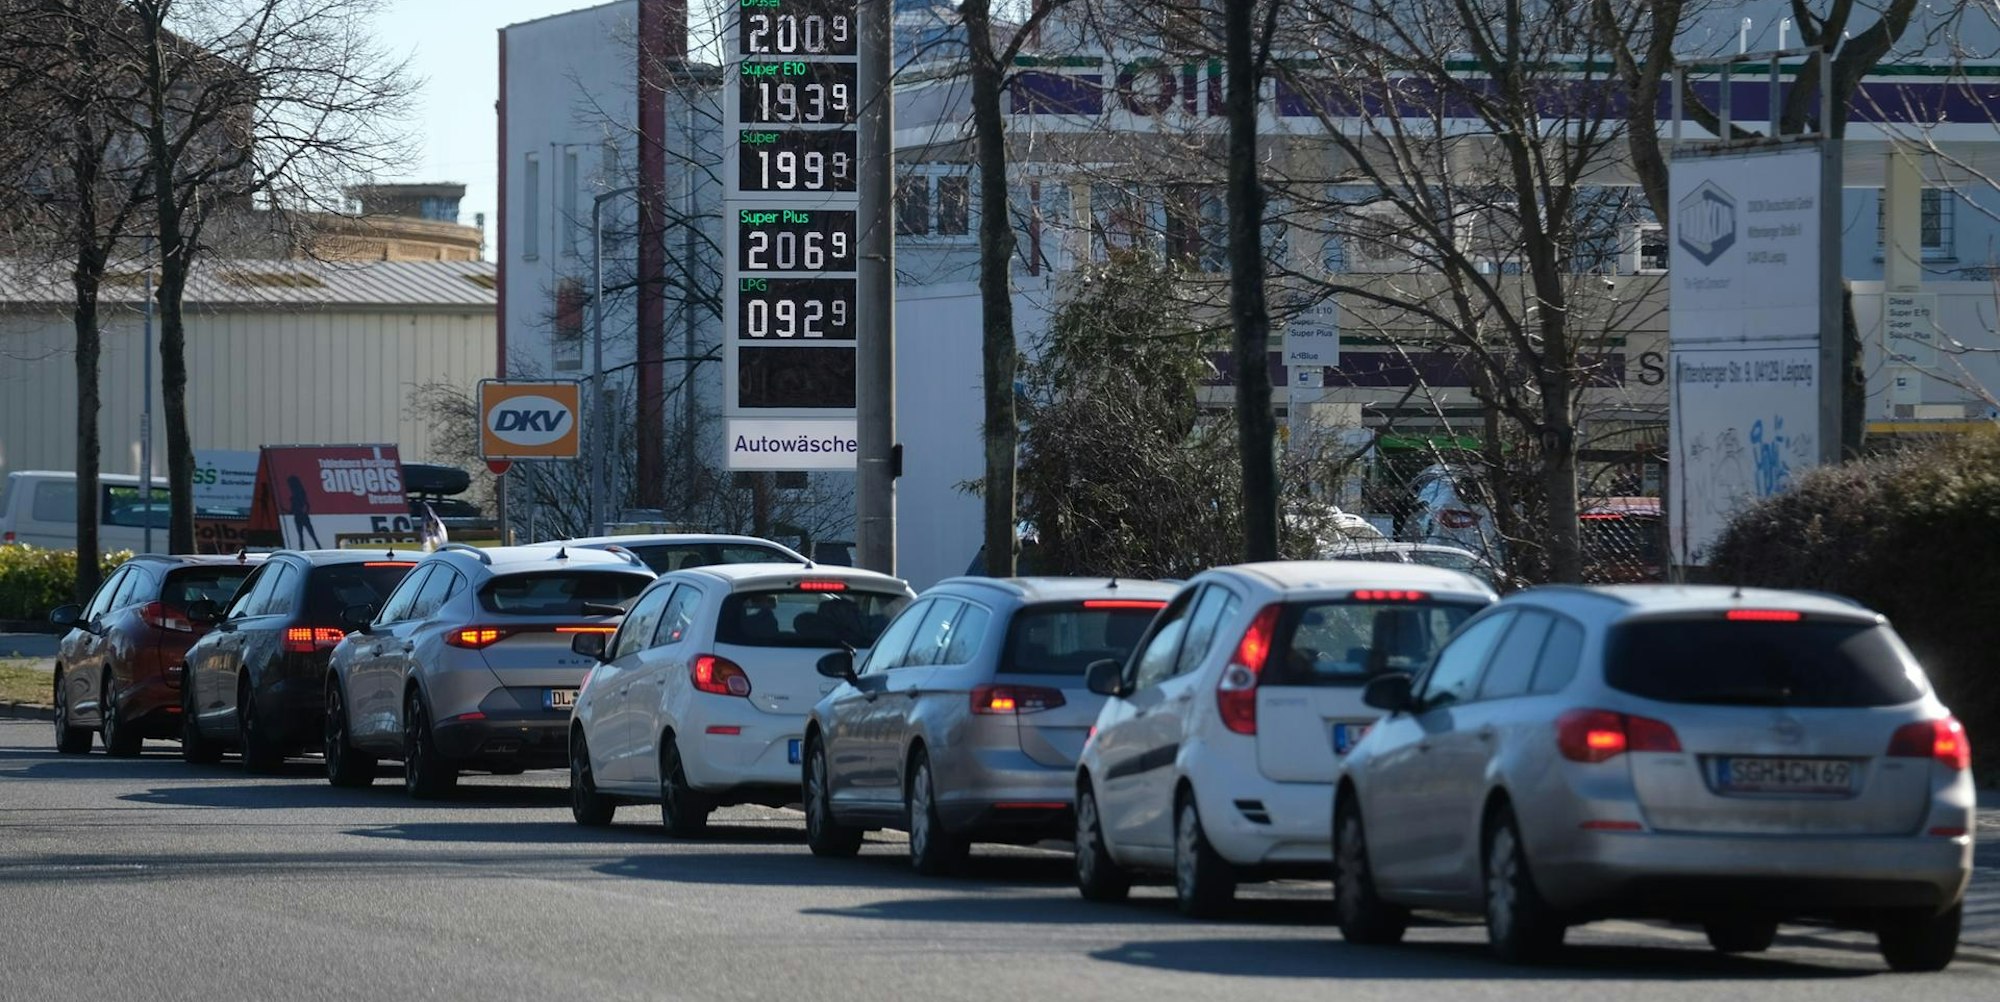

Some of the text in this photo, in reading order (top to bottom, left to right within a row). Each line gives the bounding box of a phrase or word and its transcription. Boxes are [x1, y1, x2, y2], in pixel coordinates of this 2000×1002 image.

[741, 62, 807, 77] Super E10
[741, 131, 779, 146] Super
[741, 210, 809, 224] Super Plus
[741, 278, 768, 292] LPG
[1889, 308, 1912, 316] Super
[1290, 328, 1333, 338] Super Plus
[494, 409, 568, 432] DKV
[734, 435, 858, 453] Autowäsche
[320, 447, 401, 496] angels
[553, 691, 570, 705] DL
